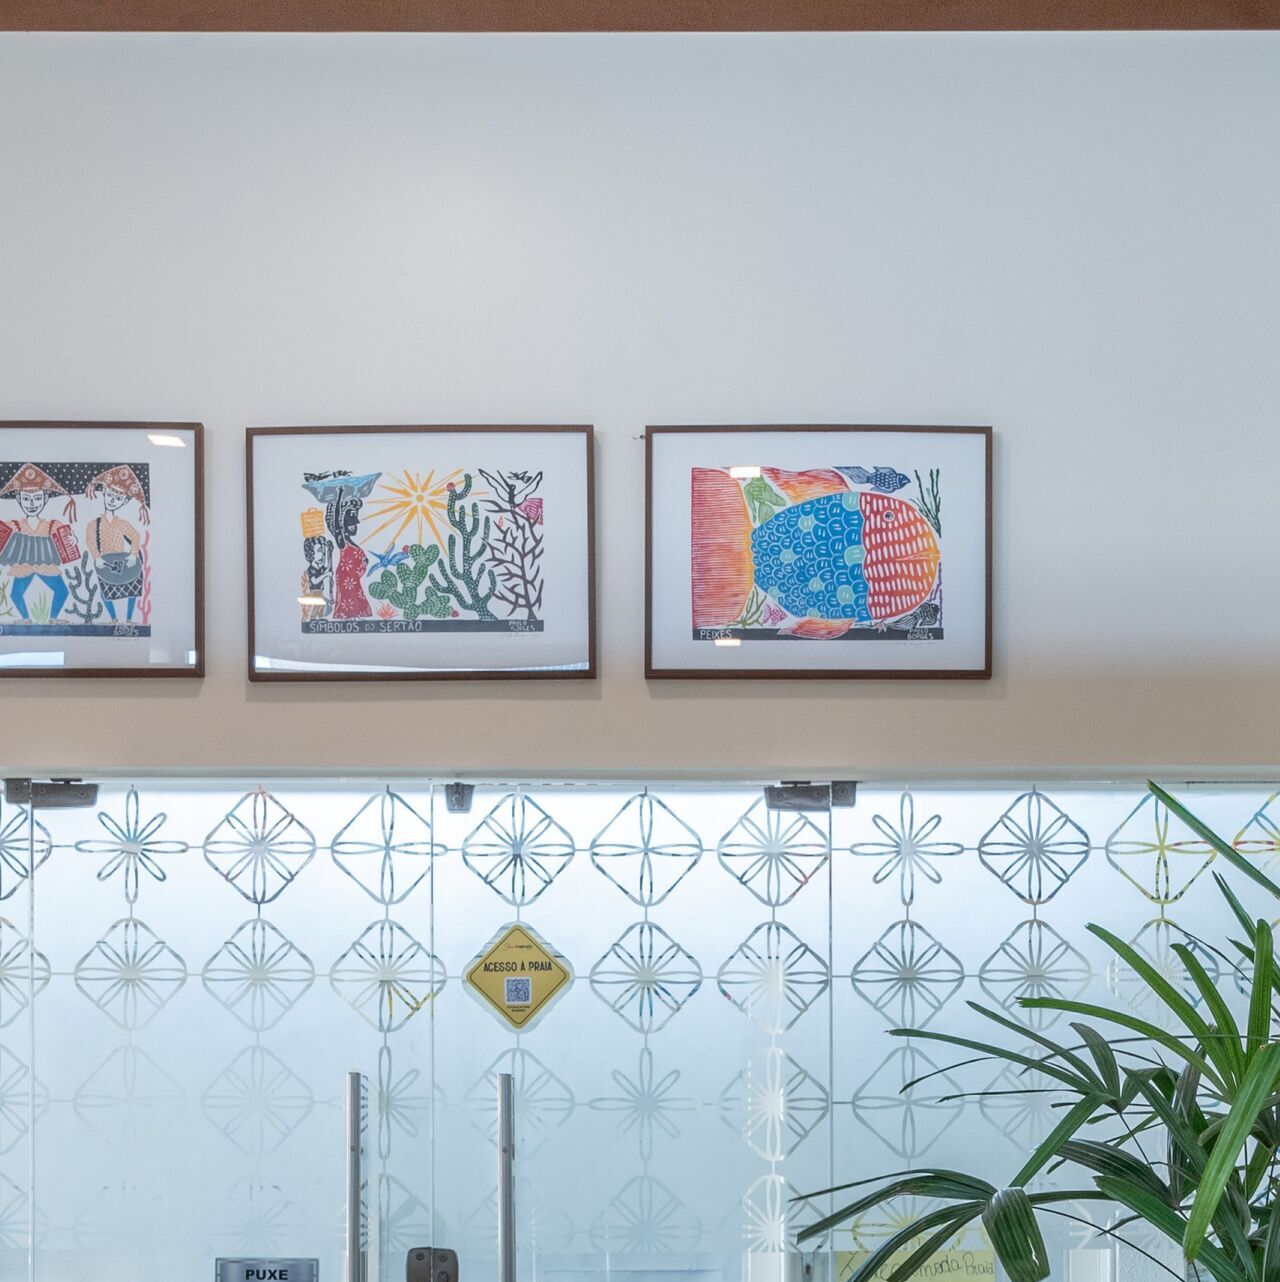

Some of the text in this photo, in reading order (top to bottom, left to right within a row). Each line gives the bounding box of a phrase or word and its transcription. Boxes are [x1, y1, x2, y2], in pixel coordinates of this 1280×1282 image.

[699, 629, 733, 640] PEIXES
[483, 961, 518, 972] ACESSO
[528, 960, 553, 971] PRAIA
[245, 1268, 289, 1281] PUXE
